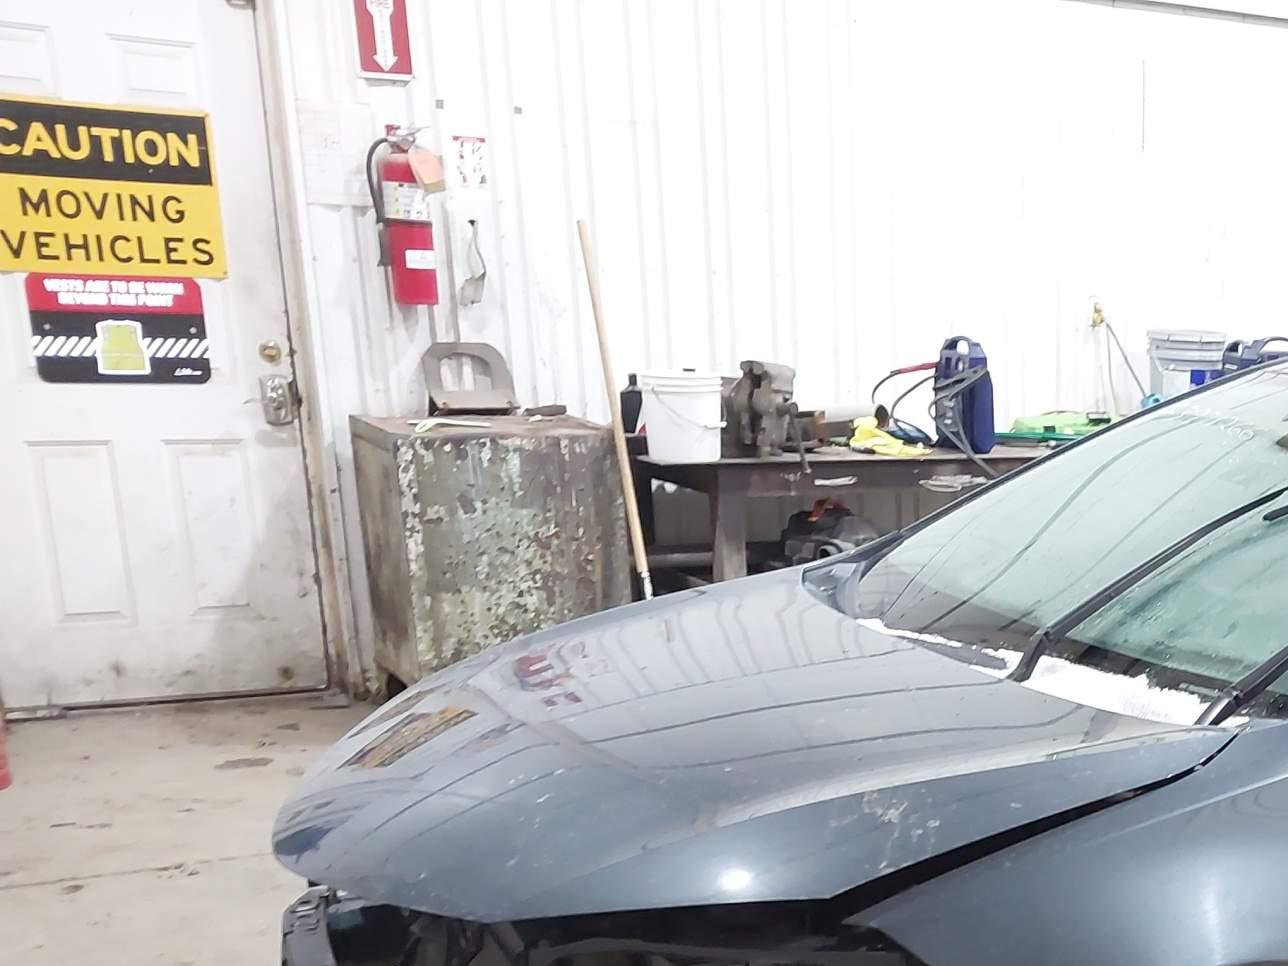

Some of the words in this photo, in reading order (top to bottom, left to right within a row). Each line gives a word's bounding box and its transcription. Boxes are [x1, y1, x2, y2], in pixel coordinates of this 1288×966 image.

[0, 118, 200, 168] CAUTION
[18, 186, 186, 224] MOVING
[0, 229, 215, 266] VEHICLES
